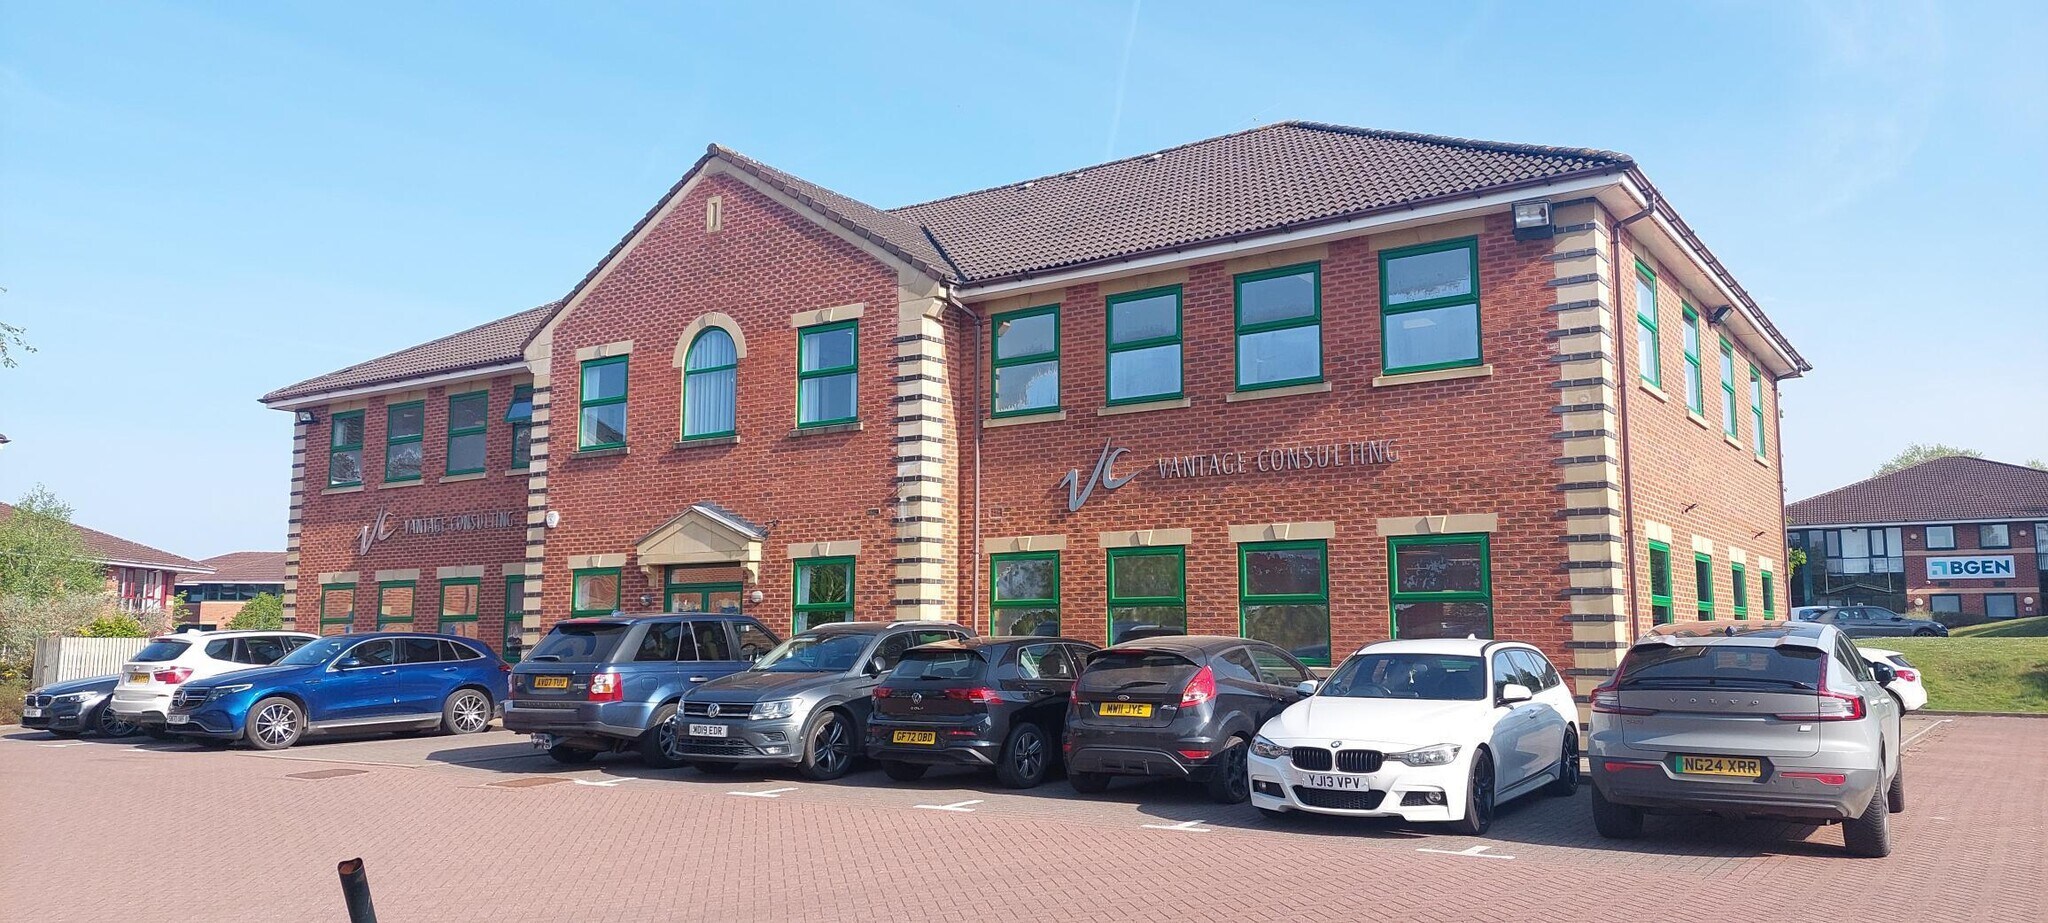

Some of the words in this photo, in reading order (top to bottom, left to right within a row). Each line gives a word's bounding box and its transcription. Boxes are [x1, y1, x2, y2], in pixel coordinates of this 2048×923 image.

[1159, 451, 1247, 479] VANTAGE
[1257, 439, 1400, 472] CONSULTING
[404, 517, 446, 535] VANTAGE
[450, 511, 514, 531] CONSULTING
[1950, 560, 2010, 574] BGEN
[1126, 705, 1144, 715] JYE
[709, 726, 723, 736] EDR
[896, 731, 916, 742] GF72
[1685, 757, 1723, 772] NG24
[1727, 760, 1757, 774] XRR
[1308, 774, 1333, 787] YJ13
[1336, 776, 1360, 788] VPV
